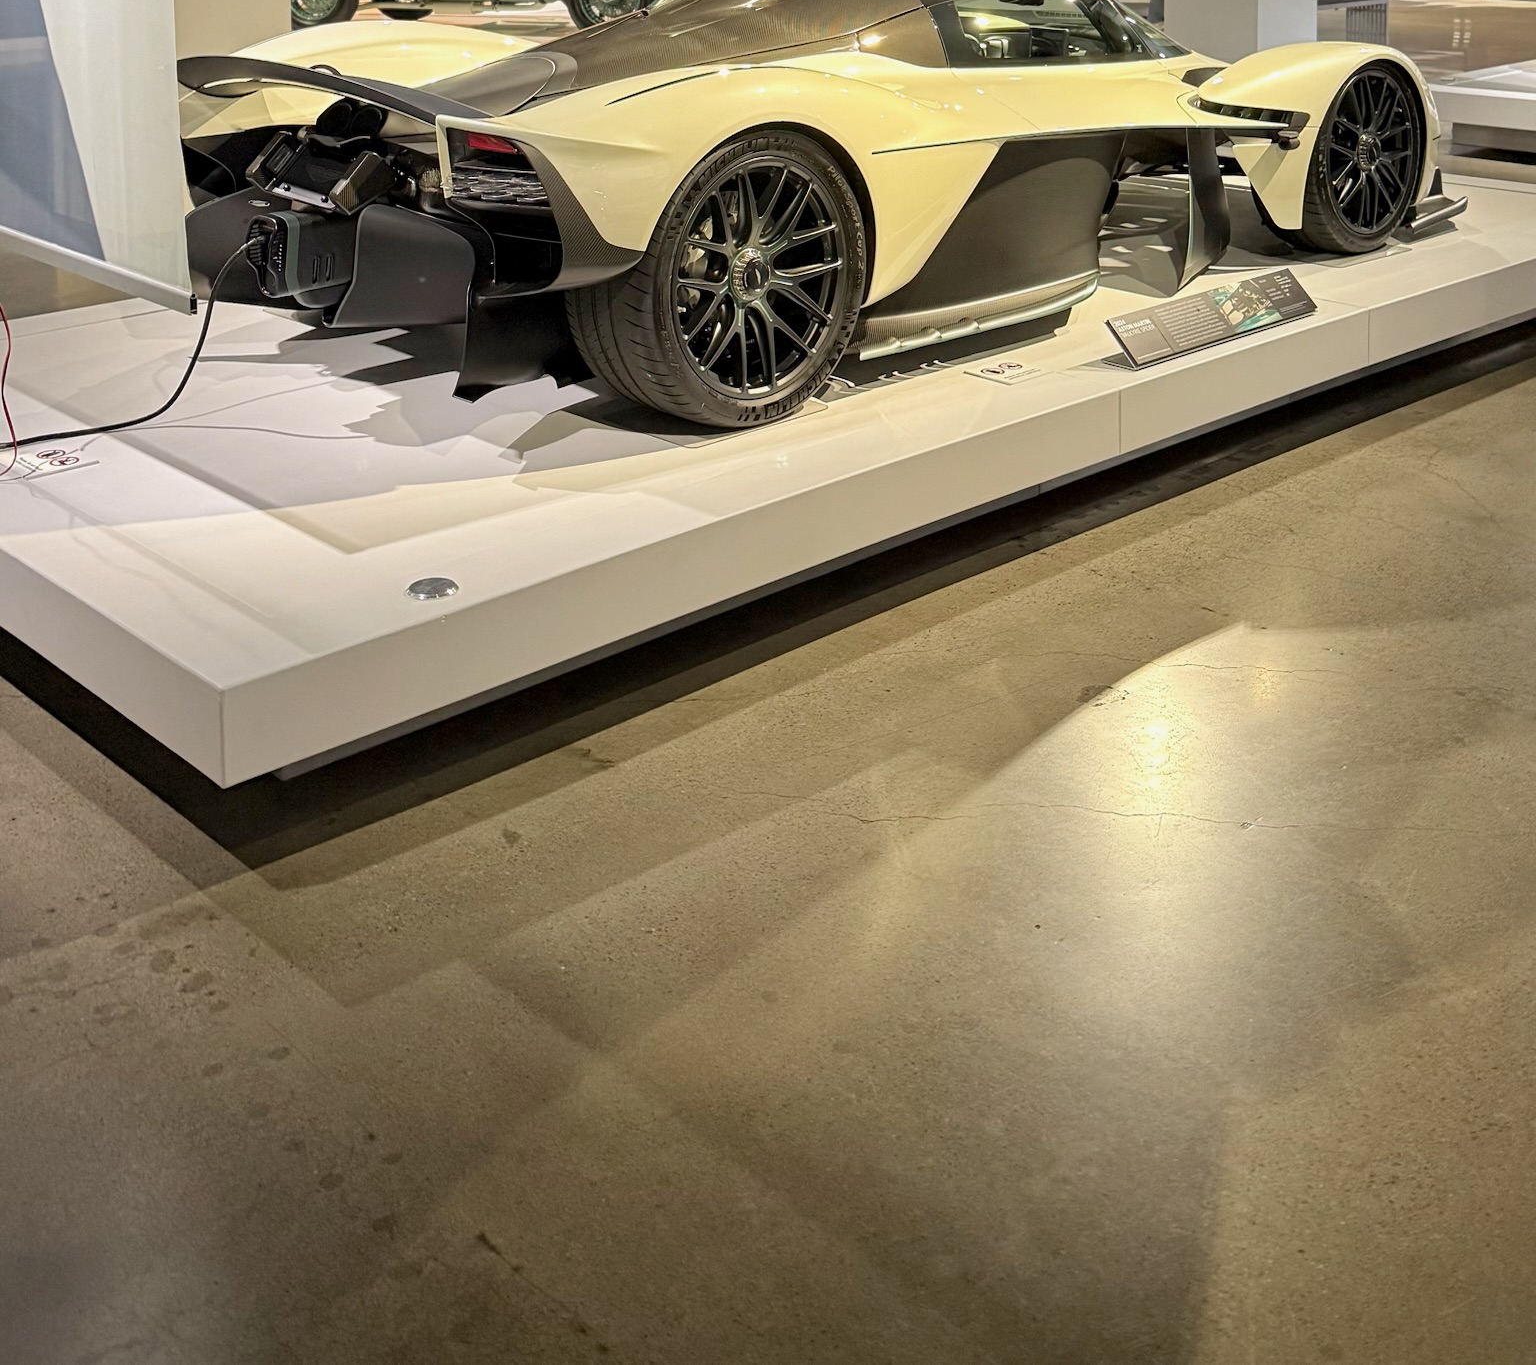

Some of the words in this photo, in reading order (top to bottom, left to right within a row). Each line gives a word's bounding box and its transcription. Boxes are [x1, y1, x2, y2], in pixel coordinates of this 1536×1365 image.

[698, 137, 769, 191] MICHELIN
[827, 165, 847, 192] Pilot
[844, 192, 861, 229] Sport
[856, 231, 864, 257] Cup
[763, 359, 832, 420] MICHELIN
